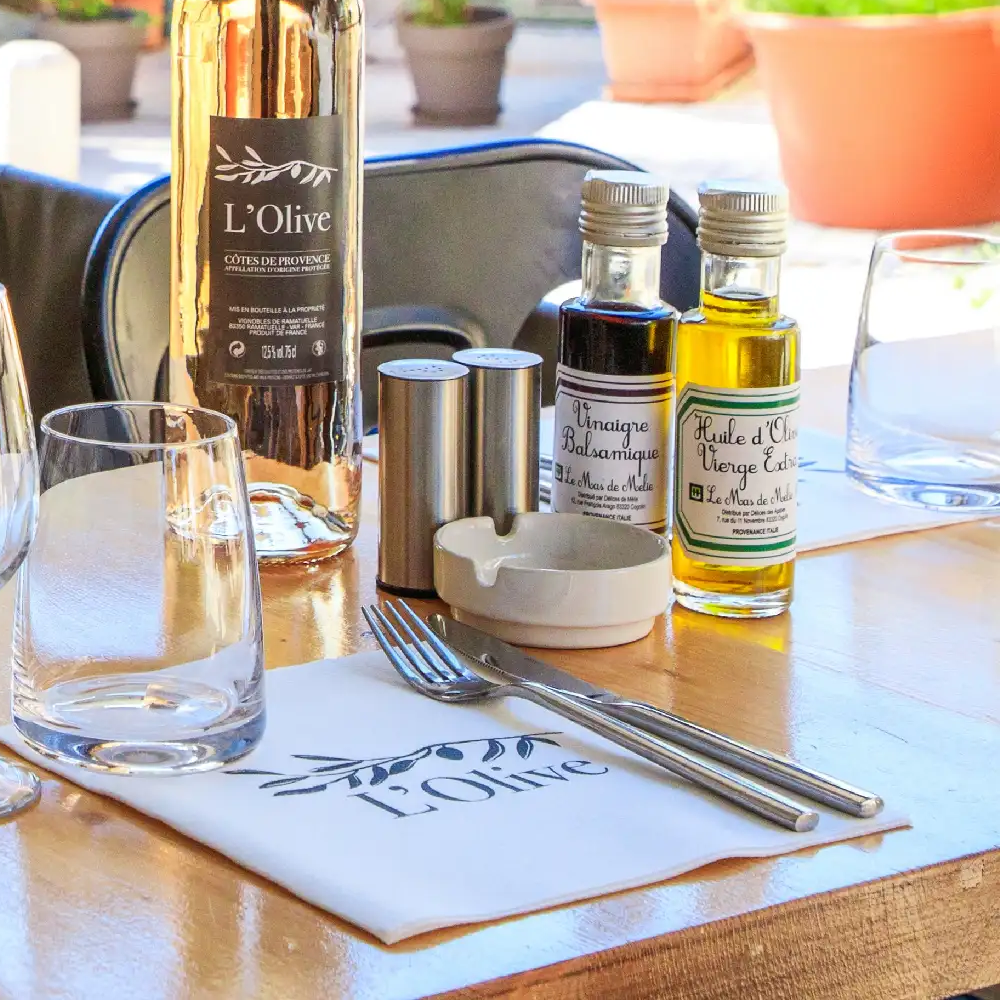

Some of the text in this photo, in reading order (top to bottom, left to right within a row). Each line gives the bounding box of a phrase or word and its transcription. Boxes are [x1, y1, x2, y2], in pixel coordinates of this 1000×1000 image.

[223, 202, 331, 235] L'Olive
[224, 254, 331, 266] CÔTES DE PROVENCE
[573, 400, 648, 449] Vinaigre
[694, 413, 746, 445] Huile
[561, 425, 660, 477] Balsamique
[697, 443, 758, 491] Vierge
[565, 464, 576, 485] Le
[577, 470, 604, 491] Mas
[607, 479, 619, 492] de
[706, 484, 722, 505] Le
[725, 487, 754, 506] Mas
[757, 493, 768, 505] de
[347, 760, 609, 820] L'Olive
